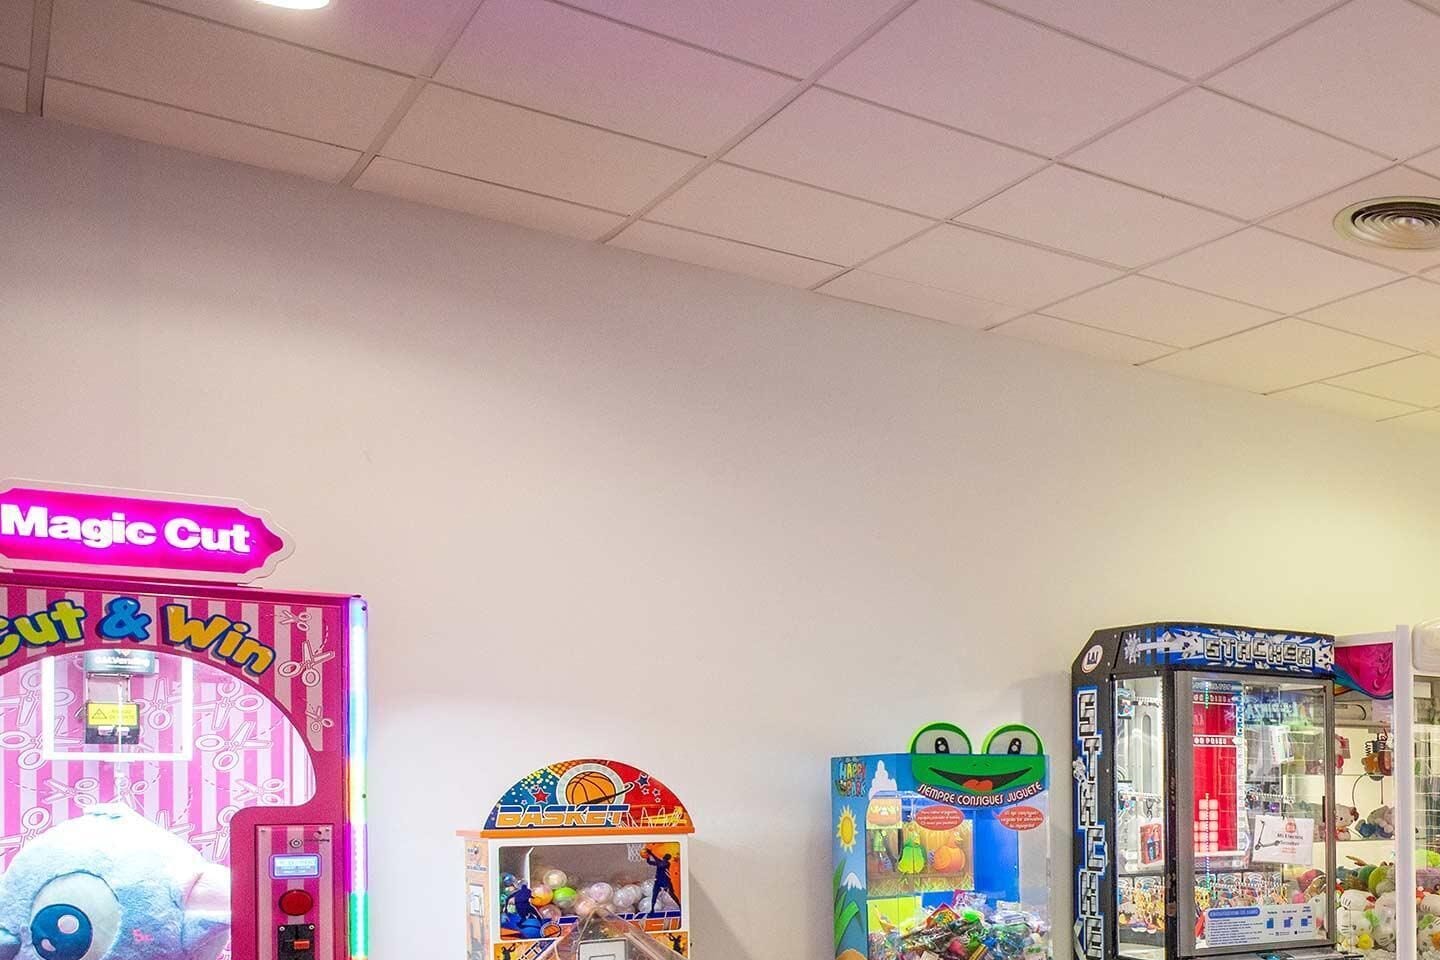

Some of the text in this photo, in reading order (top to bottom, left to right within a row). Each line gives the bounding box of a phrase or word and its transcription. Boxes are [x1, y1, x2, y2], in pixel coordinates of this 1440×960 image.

[1, 503, 251, 553] Magic Cut
[99, 597, 152, 641] &
[164, 603, 276, 674] Win
[1203, 636, 1315, 669] STACKER
[917, 781, 1043, 806] SIEMPRE CONSIGUES JUGUETE
[495, 804, 630, 828] BASKET
